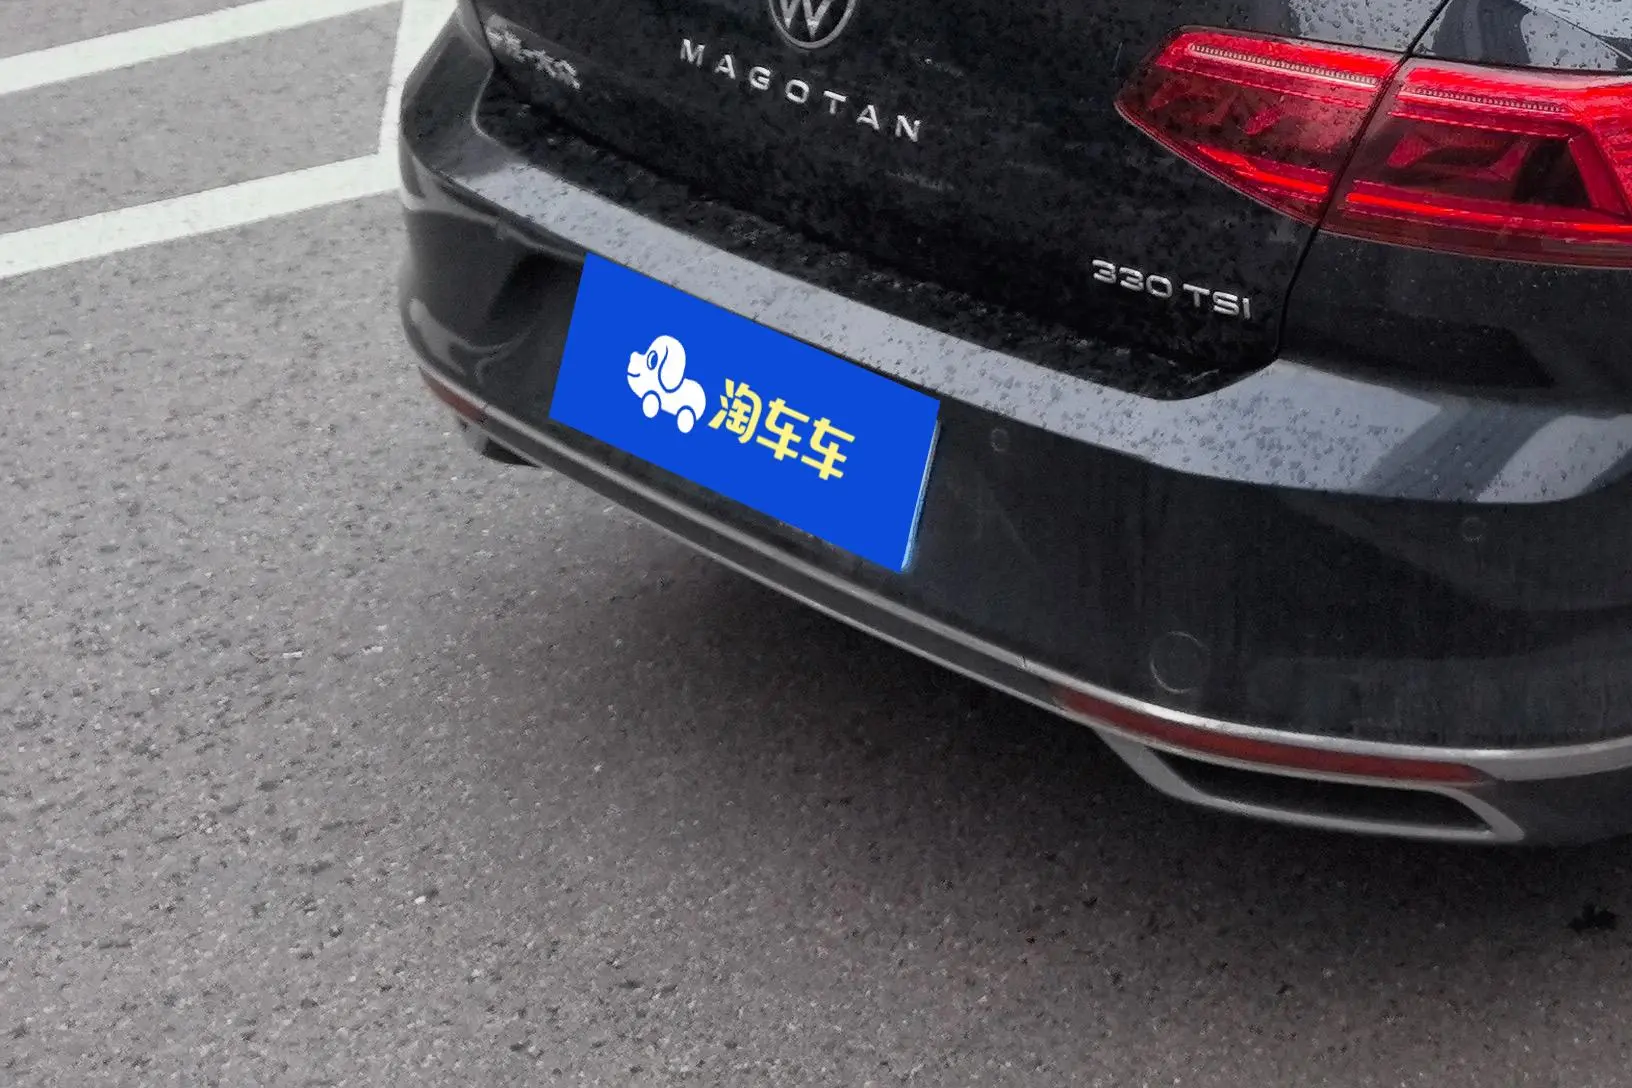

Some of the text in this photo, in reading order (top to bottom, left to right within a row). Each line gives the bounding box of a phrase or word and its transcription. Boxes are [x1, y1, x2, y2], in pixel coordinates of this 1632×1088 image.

[679, 38, 921, 143] MAGOTAN
[1092, 259, 1251, 321] 330 TSI
